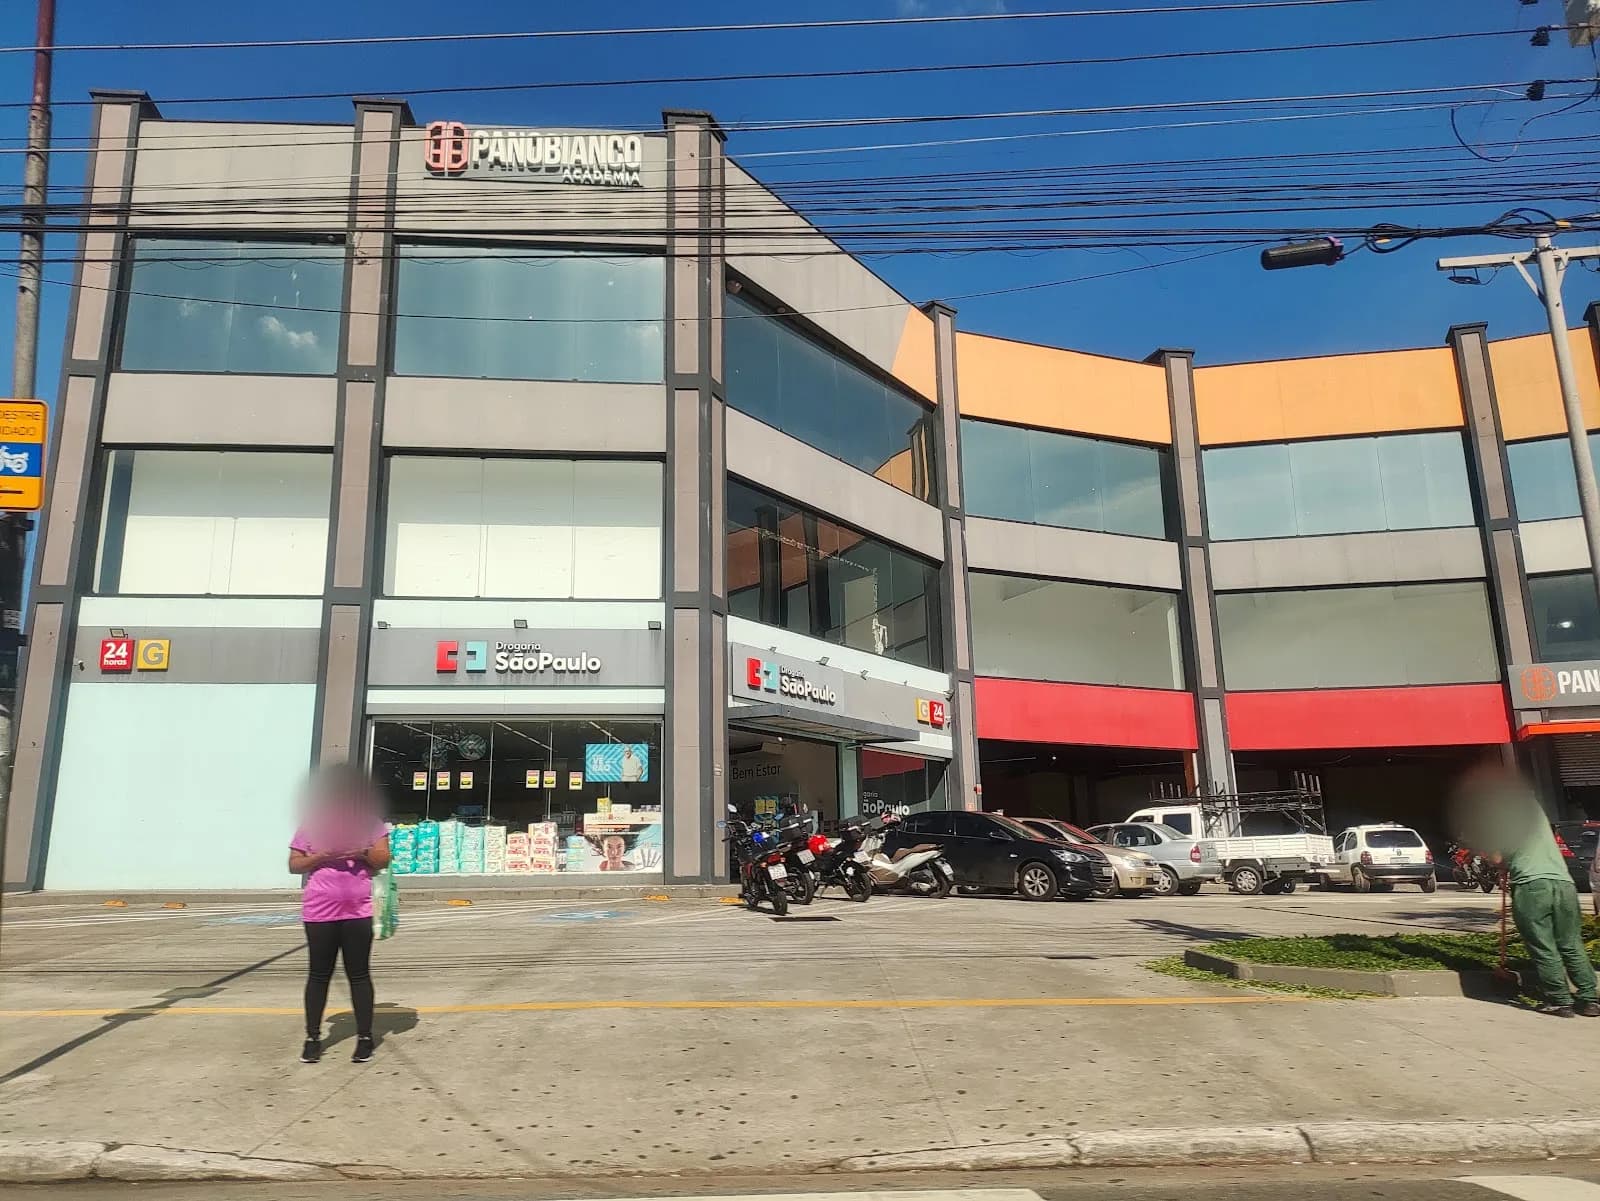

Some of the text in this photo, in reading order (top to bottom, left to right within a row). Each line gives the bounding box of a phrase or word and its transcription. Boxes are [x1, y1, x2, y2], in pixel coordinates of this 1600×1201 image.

[472, 130, 642, 169] PANOBIANCO
[562, 168, 641, 183] ACADEMIA
[0, 426, 36, 436] IDADO
[104, 642, 128, 658] 24
[142, 642, 165, 665] G
[495, 641, 541, 654] Drogaria
[103, 657, 127, 666] horas
[1557, 669, 1600, 694] PAN
[933, 703, 943, 717] 24
[732, 767, 754, 780] Bem
[863, 791, 879, 799] garia
[862, 799, 910, 816] ãoPaulo
